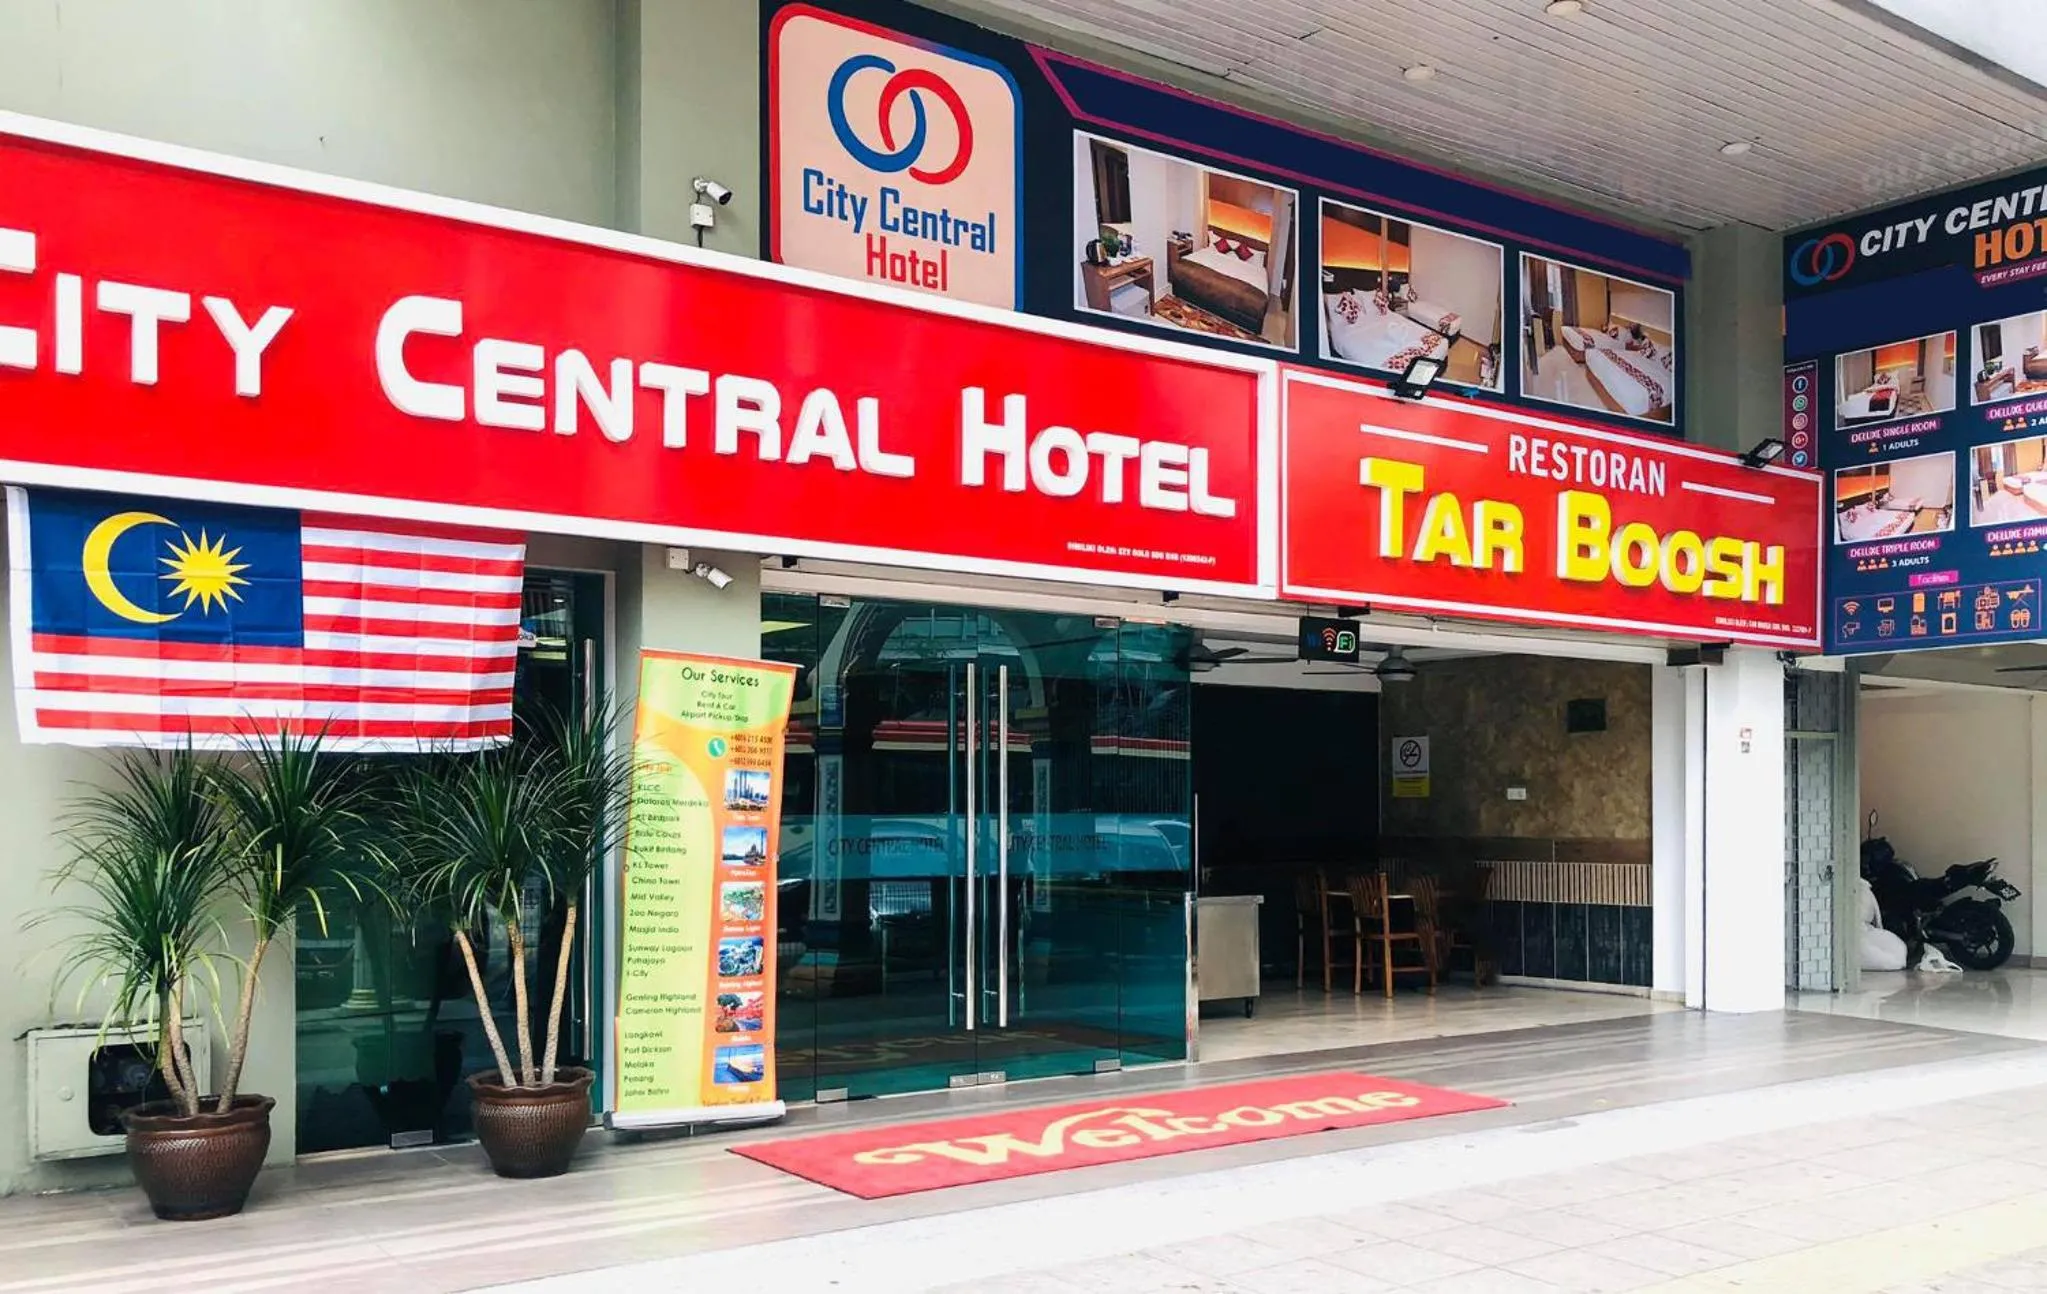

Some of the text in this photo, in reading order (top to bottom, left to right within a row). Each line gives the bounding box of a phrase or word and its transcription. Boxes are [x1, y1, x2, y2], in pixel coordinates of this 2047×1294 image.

[803, 167, 995, 254] City Central
[1860, 214, 1937, 257] CITY
[866, 232, 948, 292] Hotel
[1981, 270, 2008, 284] EVERY
[2009, 265, 2030, 277] STAY
[375, 296, 915, 479] CENTRAL
[961, 386, 1236, 518] HOTEL
[1911, 419, 1937, 433] ROOM
[1888, 438, 1920, 450] ADULTS
[1509, 433, 1666, 498] RESTORAN
[1360, 457, 1785, 605] TAR BOOSH
[1910, 539, 1936, 550] ROOM
[1898, 556, 1930, 566] ADULTS
[681, 667, 759, 687] Our Services
[631, 875, 681, 885] China Town
[630, 892, 674, 902] Mid Valley
[647, 910, 679, 919] Negara
[625, 1007, 664, 1015] Cameron
[853, 1088, 1422, 1165] Welcome
